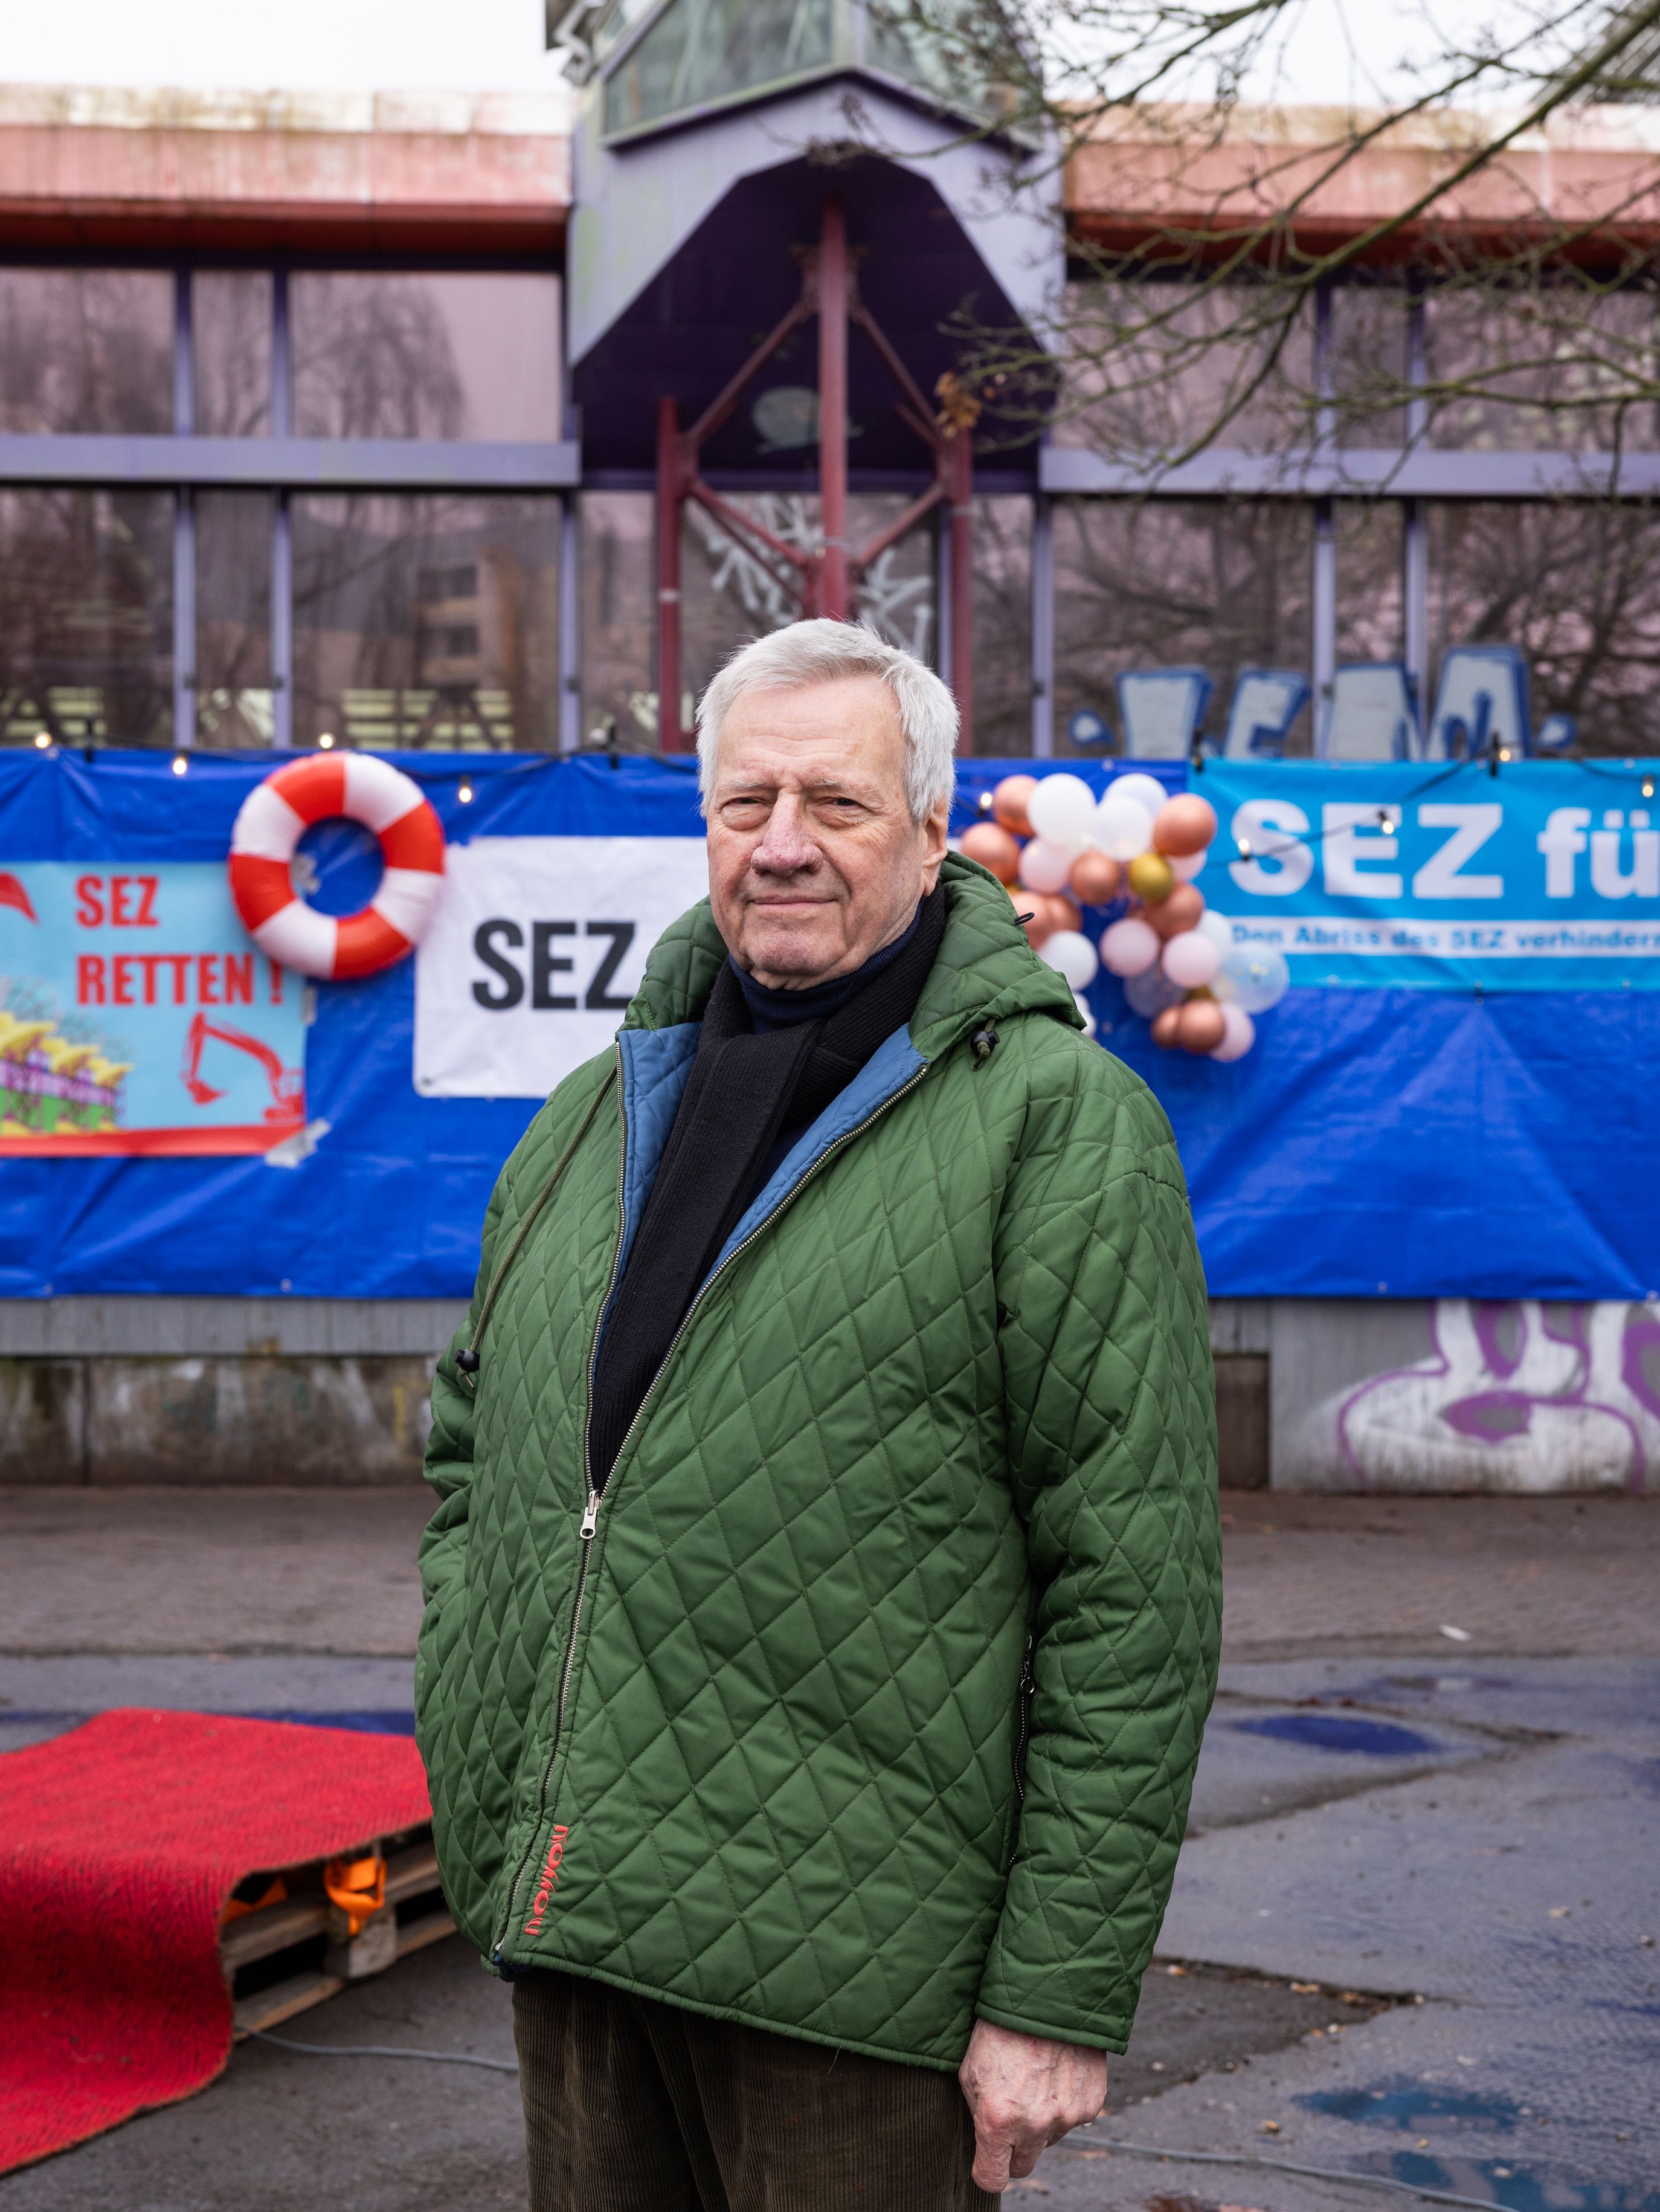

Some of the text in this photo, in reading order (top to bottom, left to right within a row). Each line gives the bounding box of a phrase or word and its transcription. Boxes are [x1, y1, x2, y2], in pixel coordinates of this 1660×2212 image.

[1229, 799, 1660, 900] SEZ fü
[76, 875, 159, 928] SEZ
[1295, 924, 1382, 946] Abriss
[1391, 928, 1440, 947] des
[1452, 928, 1504, 949] SEZ
[77, 953, 254, 1005] RETTEN
[472, 918, 636, 1011] SEZ
